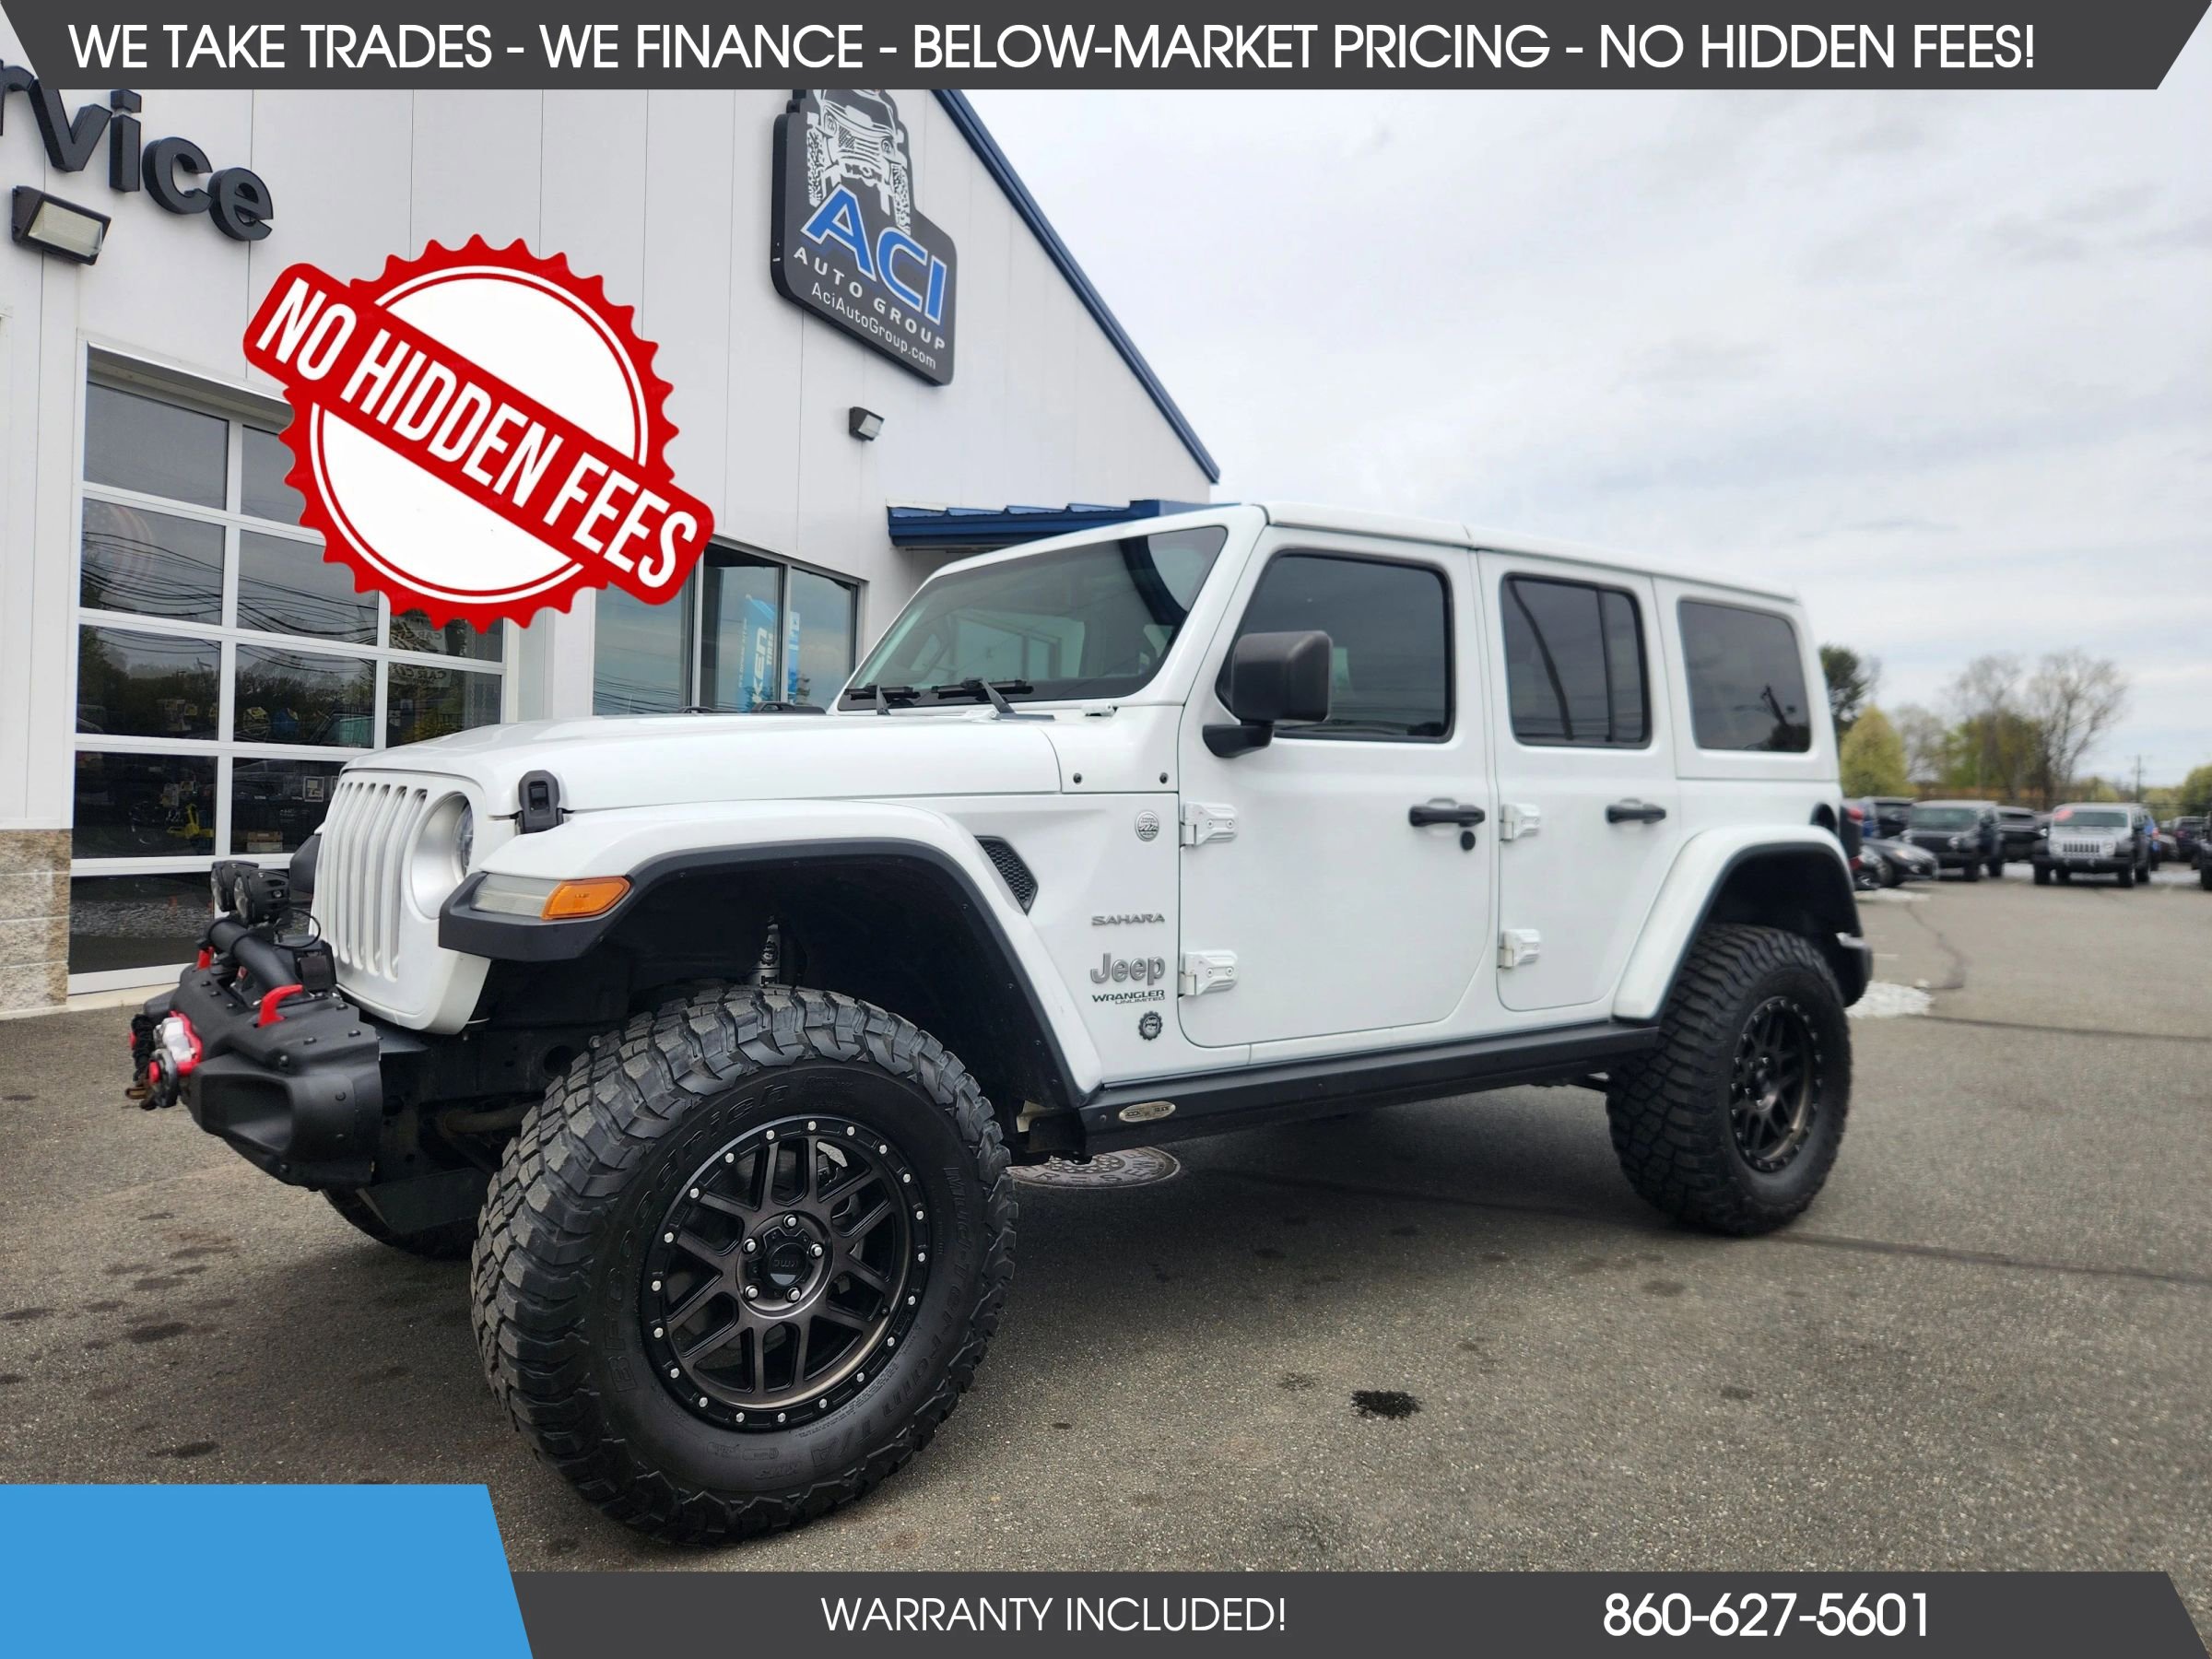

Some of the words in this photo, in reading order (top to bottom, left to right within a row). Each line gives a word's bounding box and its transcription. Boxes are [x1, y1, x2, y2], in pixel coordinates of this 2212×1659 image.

[800, 183, 947, 325] ACI
[794, 246, 864, 299] AUTO
[873, 297, 946, 350] GROUP
[811, 281, 937, 371] AciAutoGroup.com
[765, 632, 774, 666] TIRES
[1091, 912, 1166, 926] SAHARA
[1090, 952, 1166, 986] Jeep
[1091, 990, 1165, 1003] WRANGLER
[1115, 996, 1166, 1005] UNLIMITED
